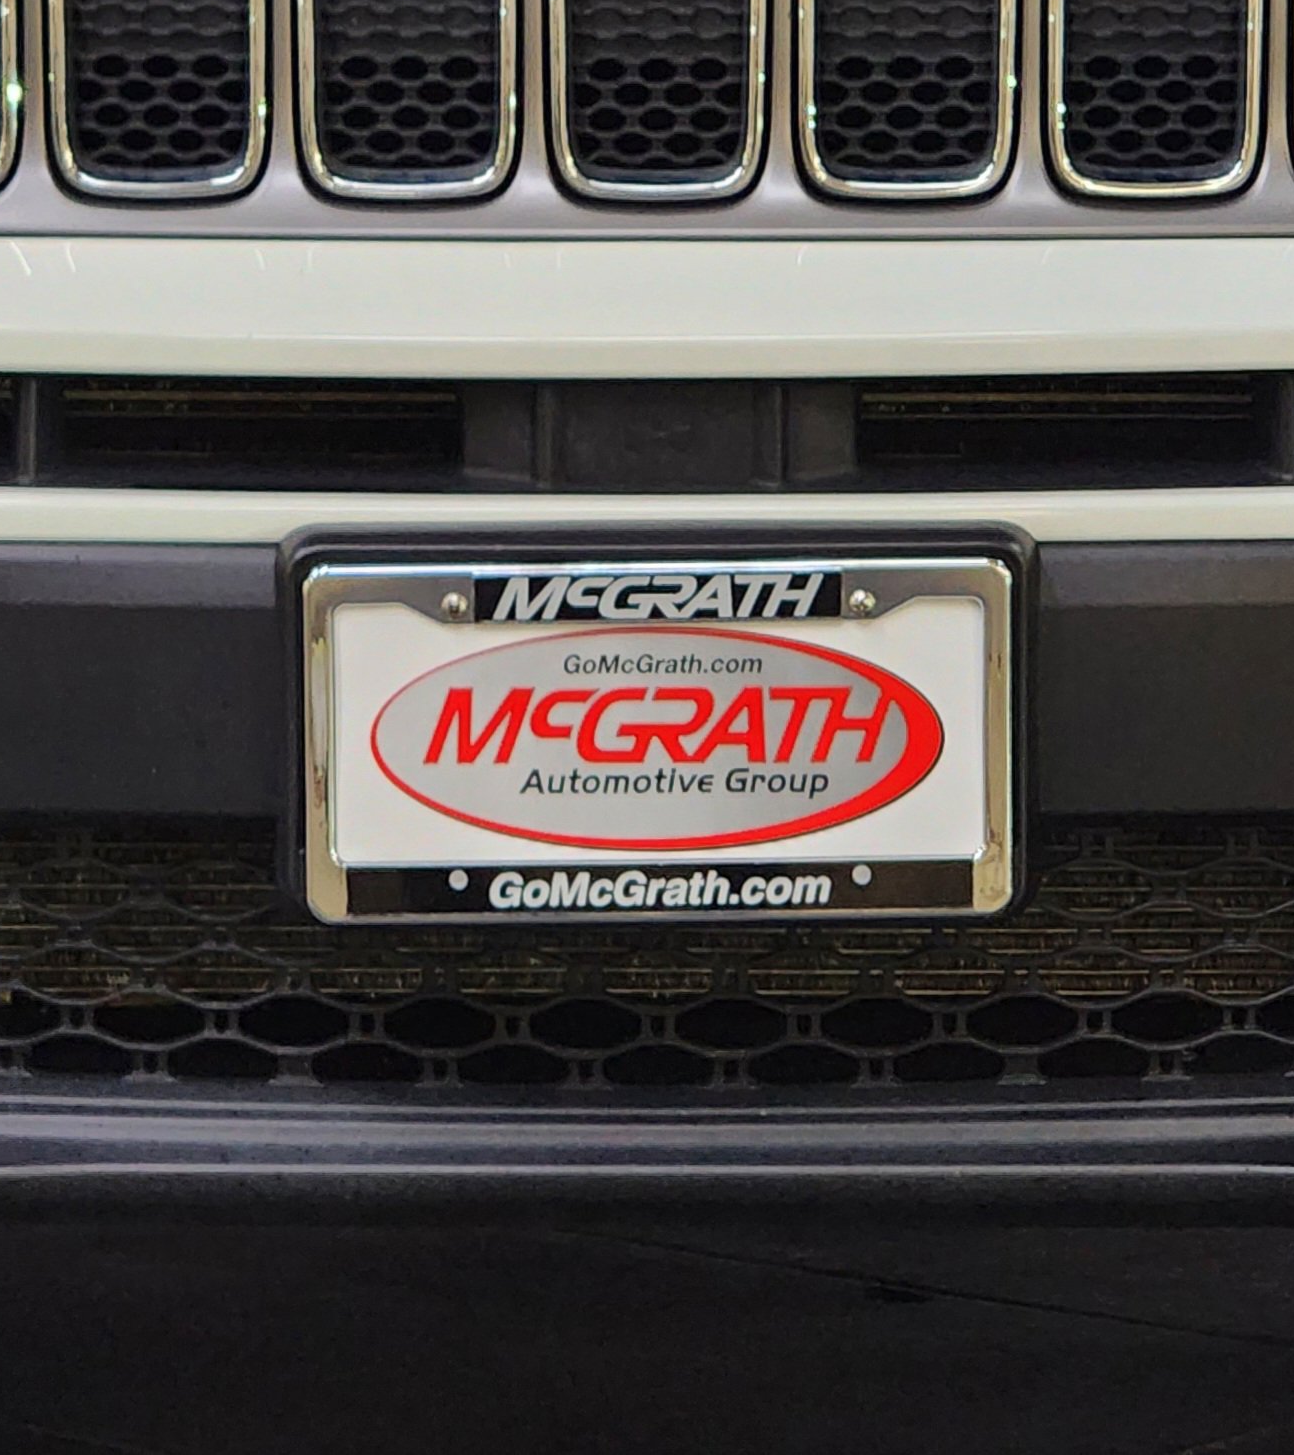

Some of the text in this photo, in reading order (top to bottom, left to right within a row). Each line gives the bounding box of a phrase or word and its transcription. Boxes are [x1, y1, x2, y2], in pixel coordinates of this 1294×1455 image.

[563, 652, 763, 676] GoMcGrath.com
[519, 767, 831, 800] Automotive Group
[489, 870, 833, 910] GoMcGrath.com
